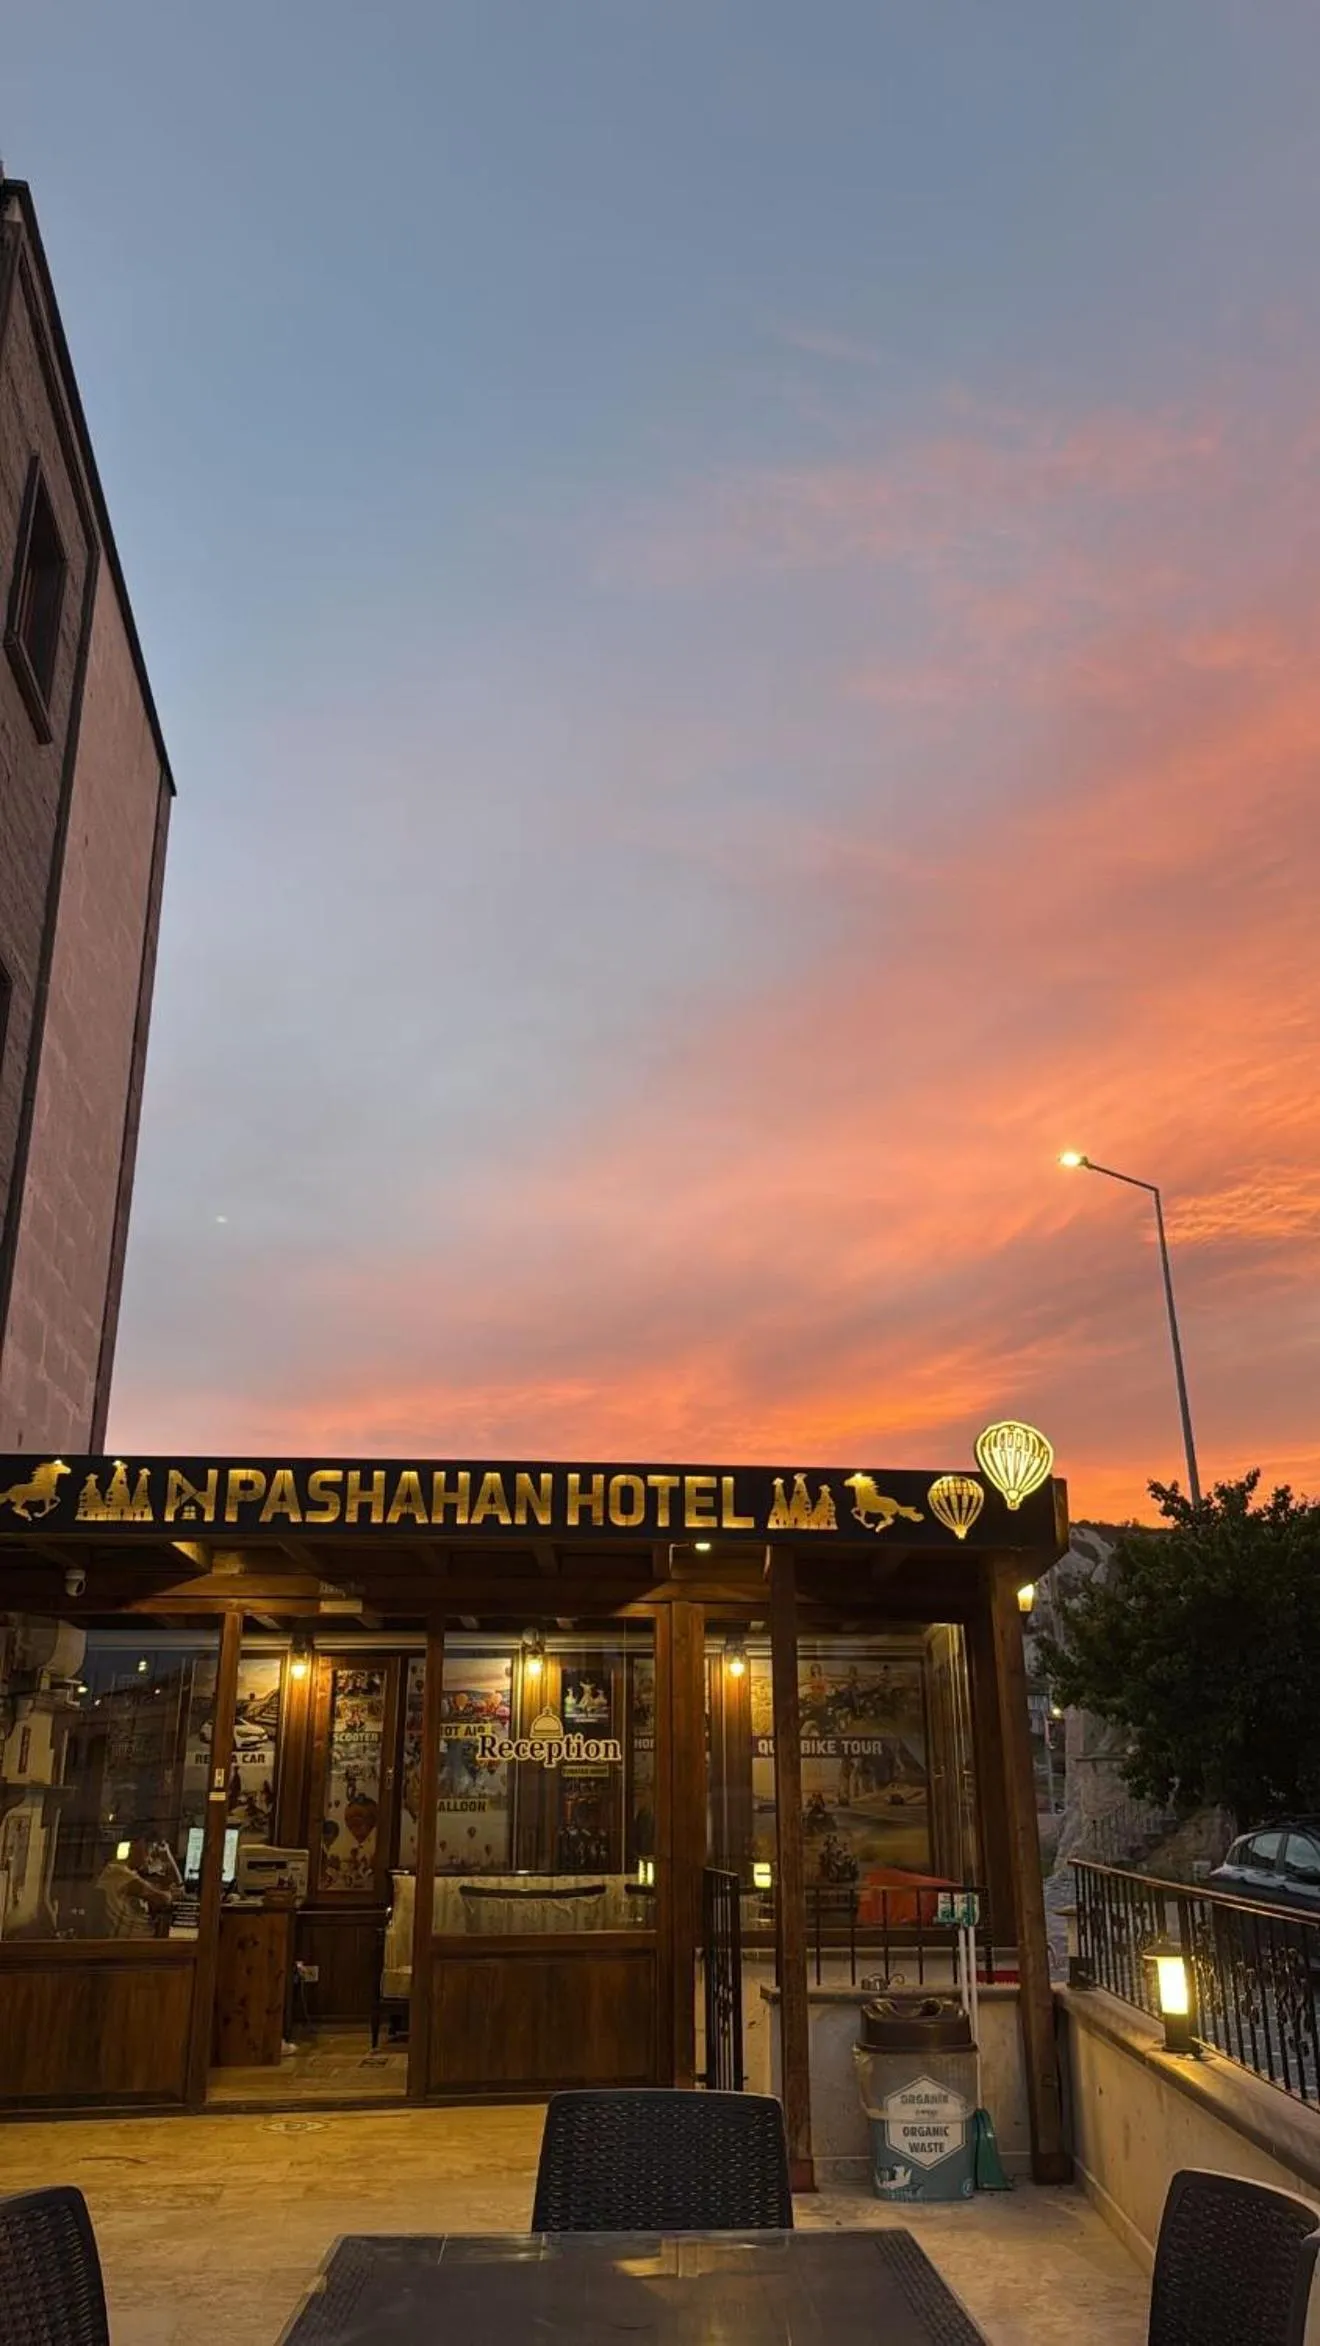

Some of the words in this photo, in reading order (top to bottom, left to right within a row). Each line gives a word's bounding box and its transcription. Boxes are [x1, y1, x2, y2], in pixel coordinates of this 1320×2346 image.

[225, 1469, 553, 1525] PASHAHAN
[567, 1473, 755, 1529] HOTEL
[476, 1733, 622, 1767] Reception
[800, 1739, 838, 1755] BIKE
[841, 1740, 883, 1755] TOUR
[242, 1753, 266, 1764] CAR
[438, 1801, 486, 1813] ALLOON
[902, 2126, 950, 2137] ORGANIC
[908, 2142, 945, 2153] WASTE
